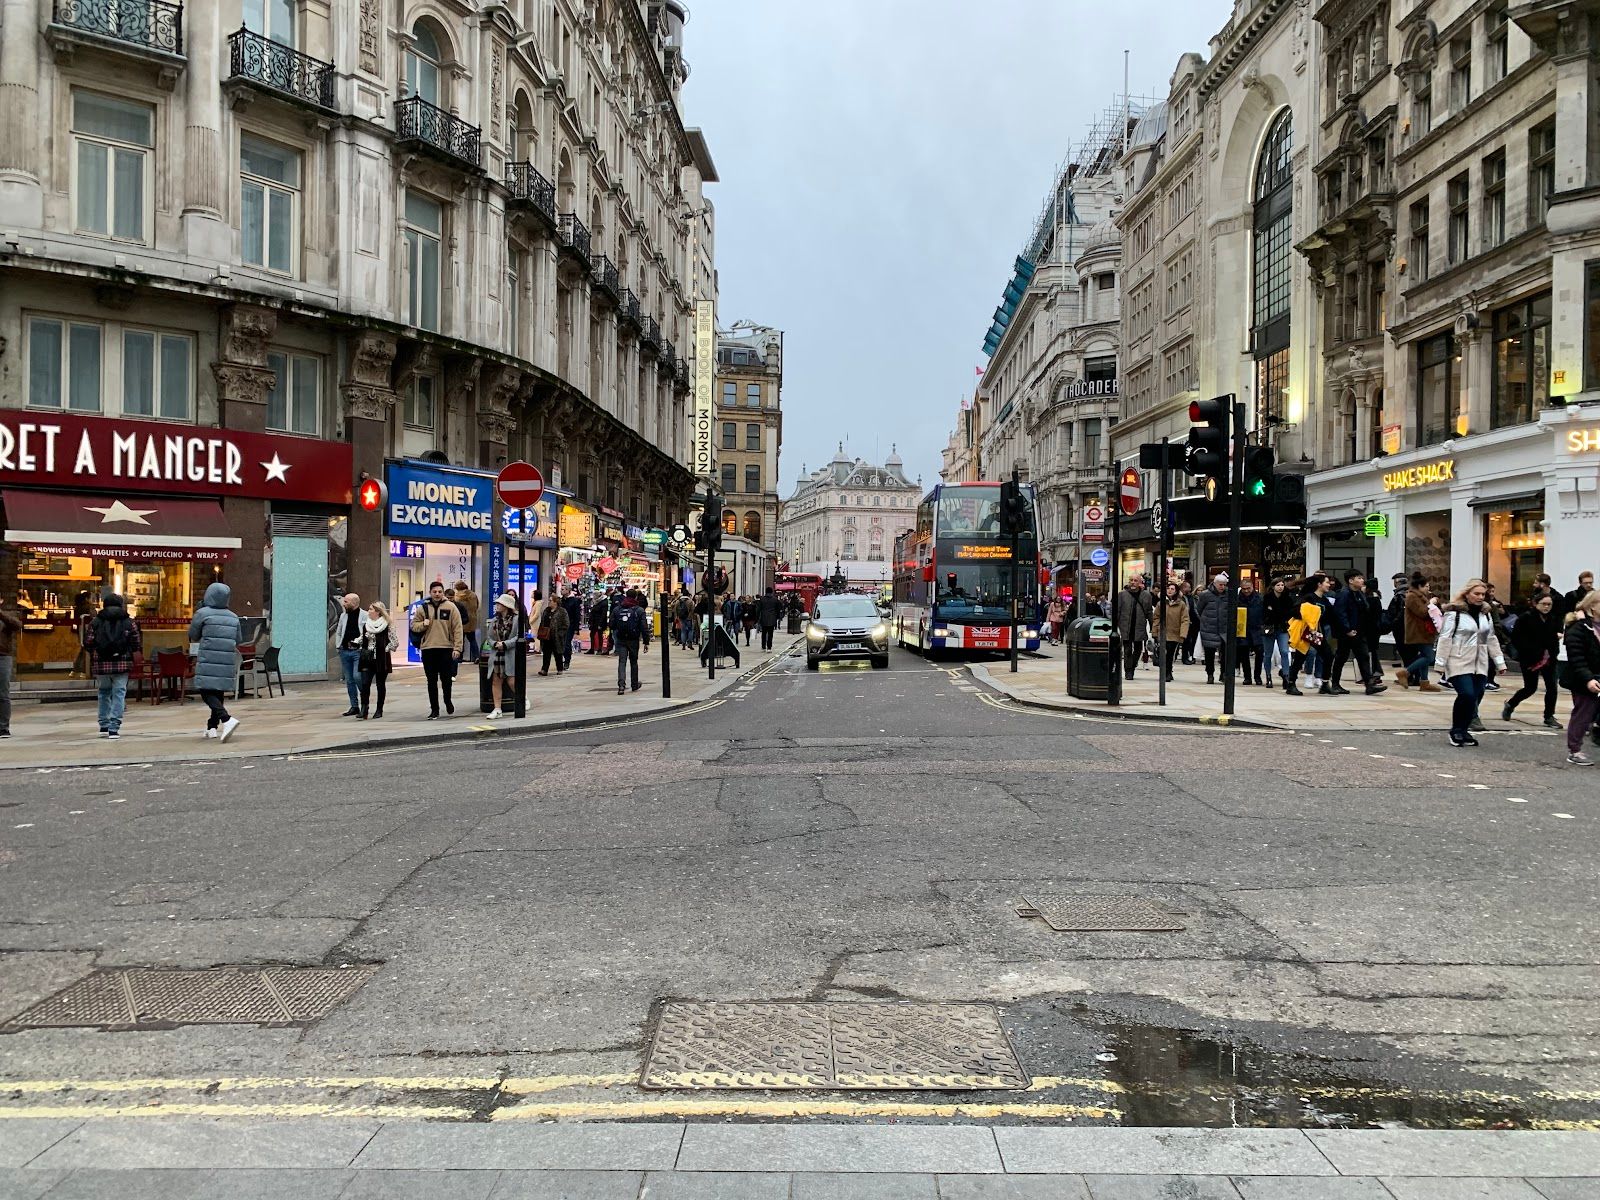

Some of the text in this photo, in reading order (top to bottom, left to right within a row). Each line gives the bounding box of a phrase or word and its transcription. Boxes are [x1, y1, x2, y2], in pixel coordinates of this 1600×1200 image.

[697, 303, 711, 474] THE BOOK OF MORMON
[1065, 379, 1120, 399] TROCADER
[73, 428, 97, 475] A
[113, 430, 243, 485] MANGER
[1383, 459, 1454, 492] SHAKE SHACK
[408, 481, 477, 507] MONEY
[391, 504, 492, 530] EXCHANGE
[92, 548, 130, 557] BAGUETTES
[141, 550, 183, 559] CAPPUCCINO
[196, 552, 219, 560] WRAPS
[974, 545, 996, 553] Original
[459, 548, 468, 580] MONE
